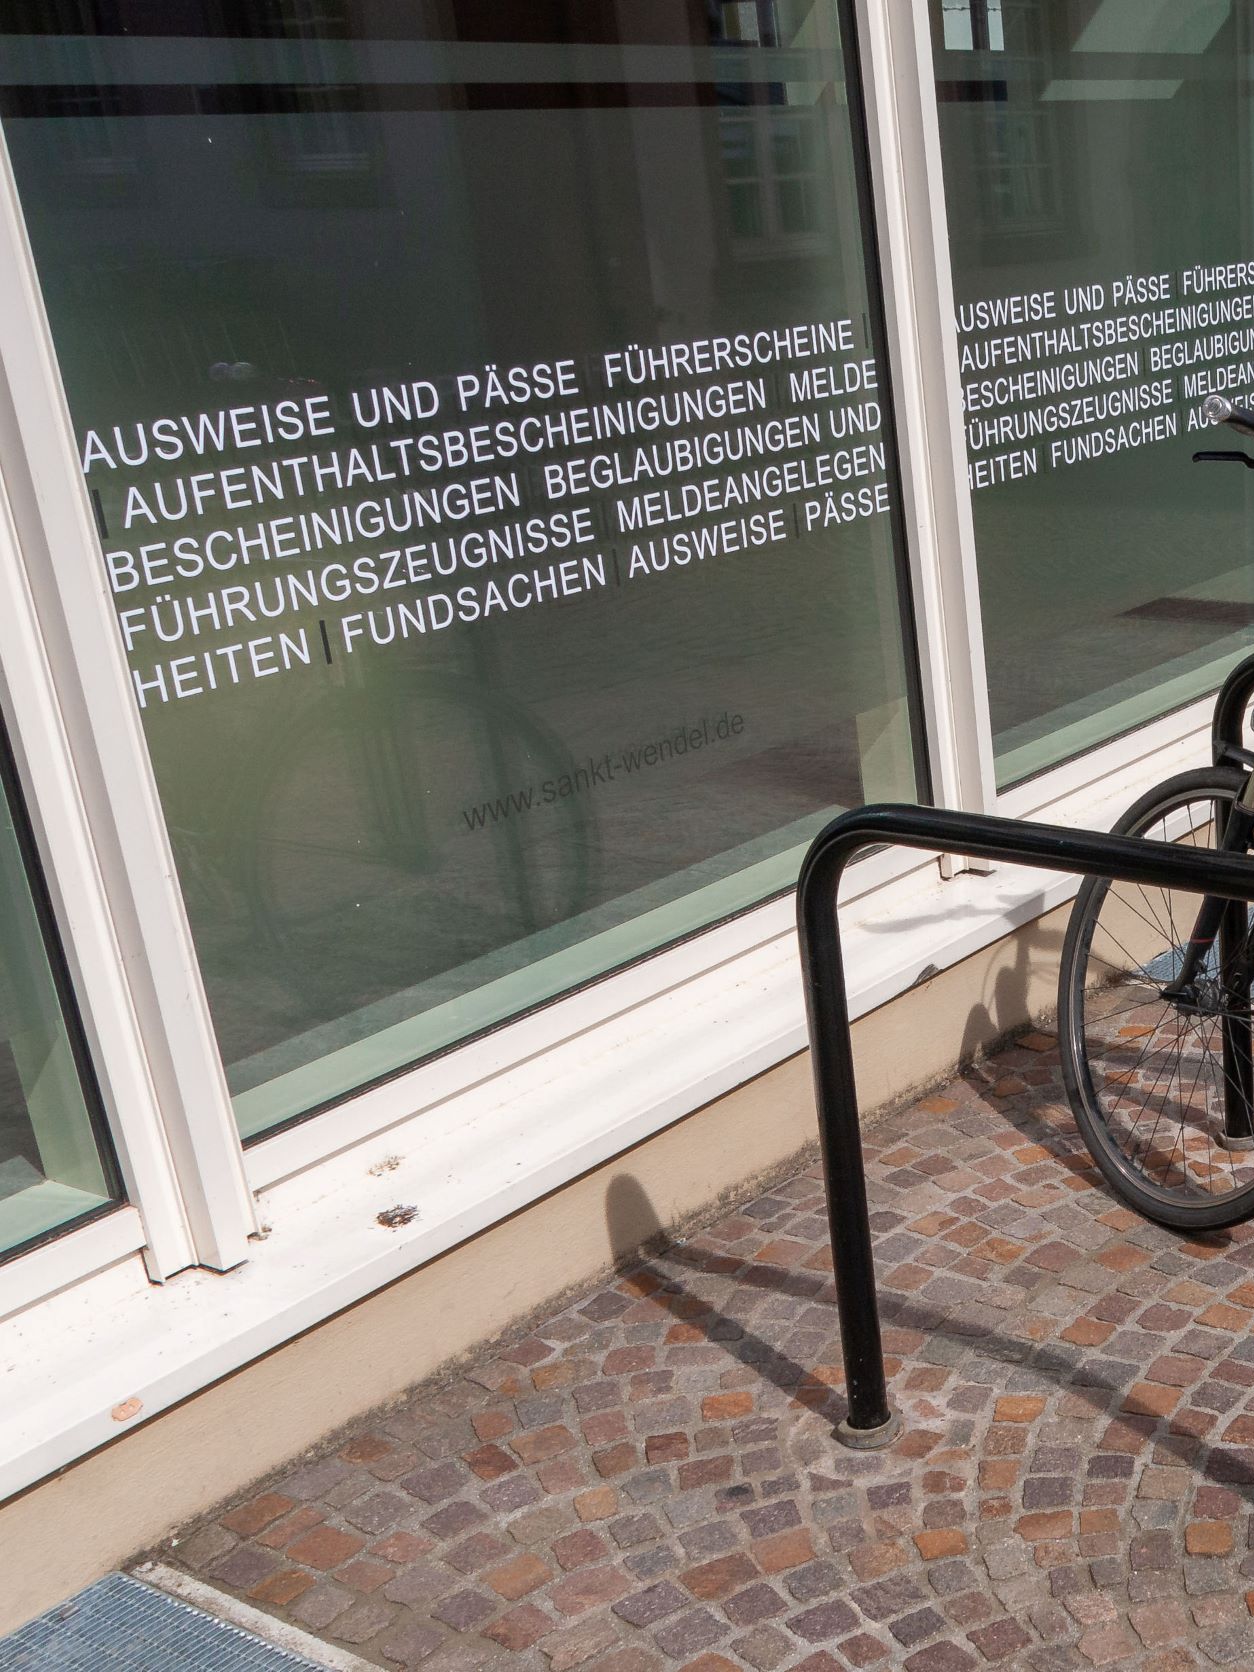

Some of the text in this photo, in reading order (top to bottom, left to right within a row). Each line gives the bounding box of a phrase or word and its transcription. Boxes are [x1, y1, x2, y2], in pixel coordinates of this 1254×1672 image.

[1064, 284, 1104, 316] UND
[1112, 273, 1171, 308] PÄSSE
[83, 319, 855, 473] AUSWEISE UND PÄSSE FÜHRERSCHEINE
[124, 359, 879, 529] AUFENTHALTSBESCHEINIGUNGEN MELDE
[964, 379, 1173, 450] ÜHRUNGSZEUGNISSE
[1051, 412, 1177, 469] FUNDSACHEN
[105, 401, 882, 593] BESCHEINIGUNGEN BEGLAUBIGUNGEN UND
[119, 442, 887, 652] FÜHRUNGSZEUGNISSE MELDEANGELEGEN
[132, 482, 891, 709] HEITEN FUNDSACHEN AUSWEISE PÄSSE
[463, 711, 745, 831] www.sankt-wendel.de
